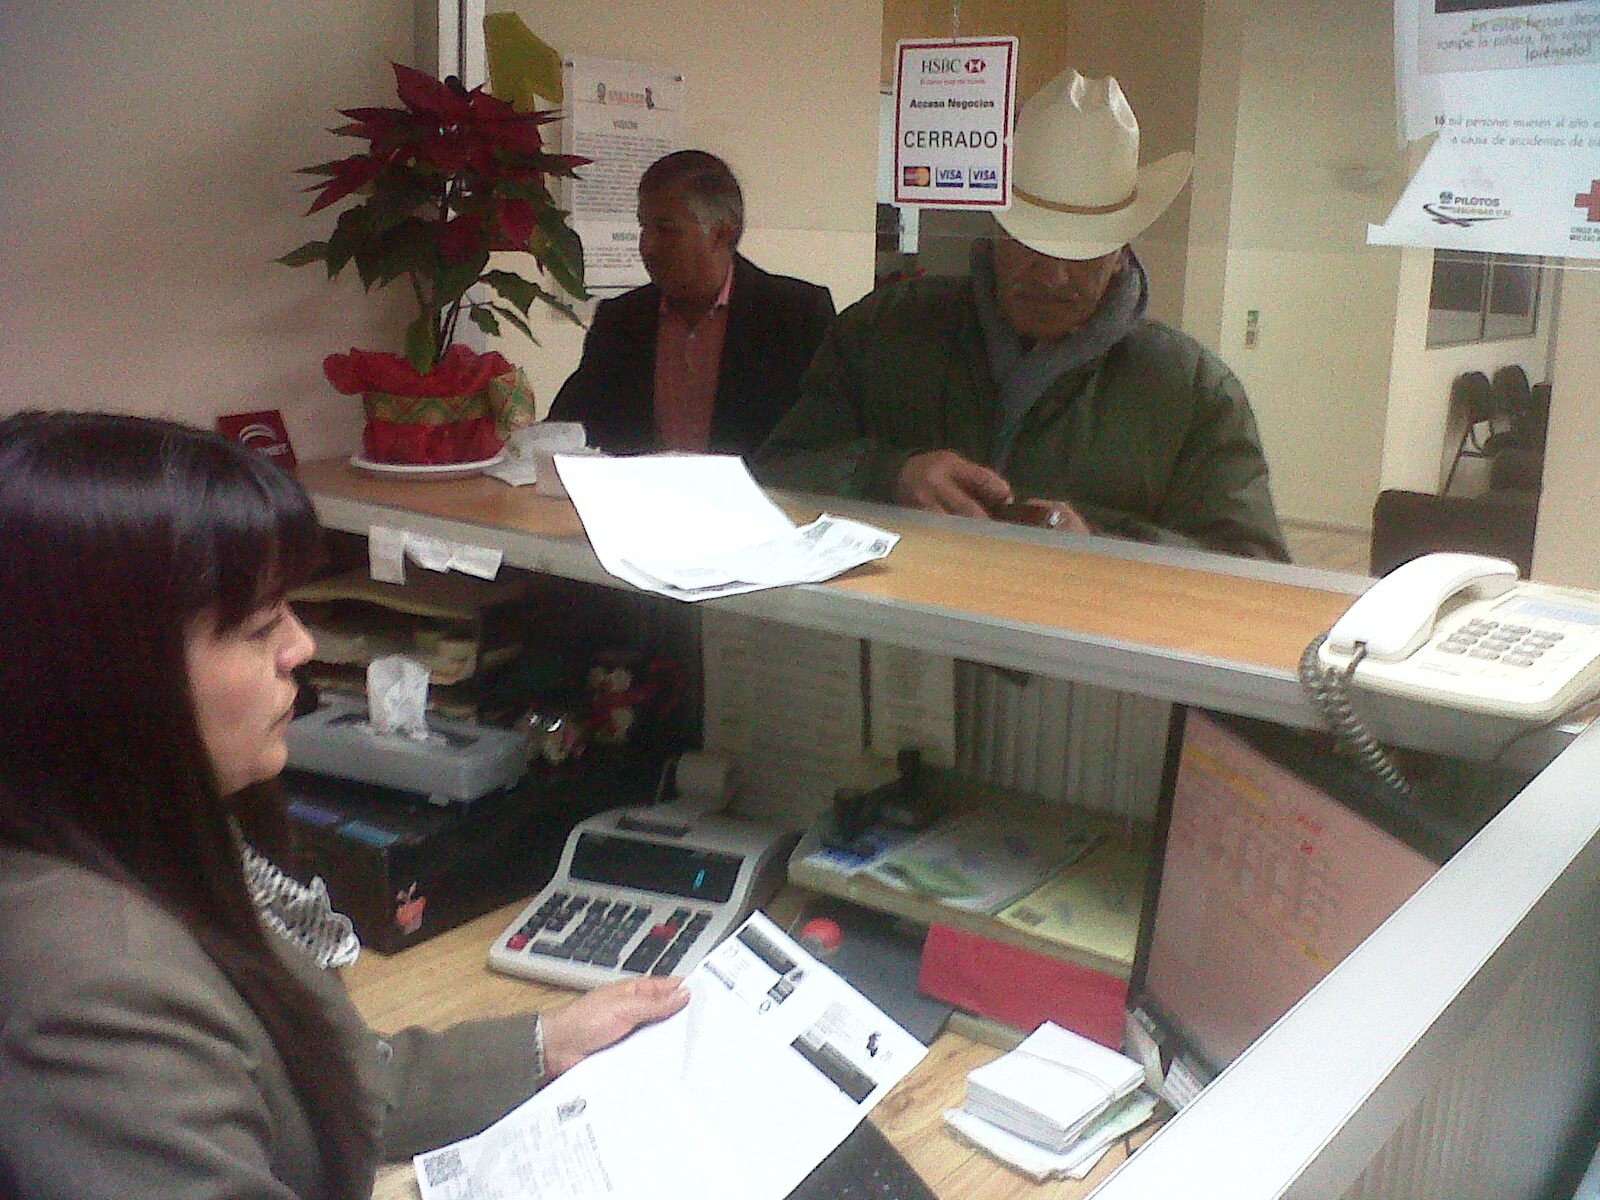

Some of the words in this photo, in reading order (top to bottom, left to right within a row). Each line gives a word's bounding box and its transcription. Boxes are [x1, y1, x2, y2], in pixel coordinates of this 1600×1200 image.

[921, 58, 962, 74] HSBC
[909, 99, 945, 109] Acceso
[948, 99, 995, 110] Negocios
[904, 130, 998, 149] CERRADO
[940, 169, 963, 180] VISA
[973, 170, 997, 181] VISA
[1454, 196, 1501, 208] PILOTOS
